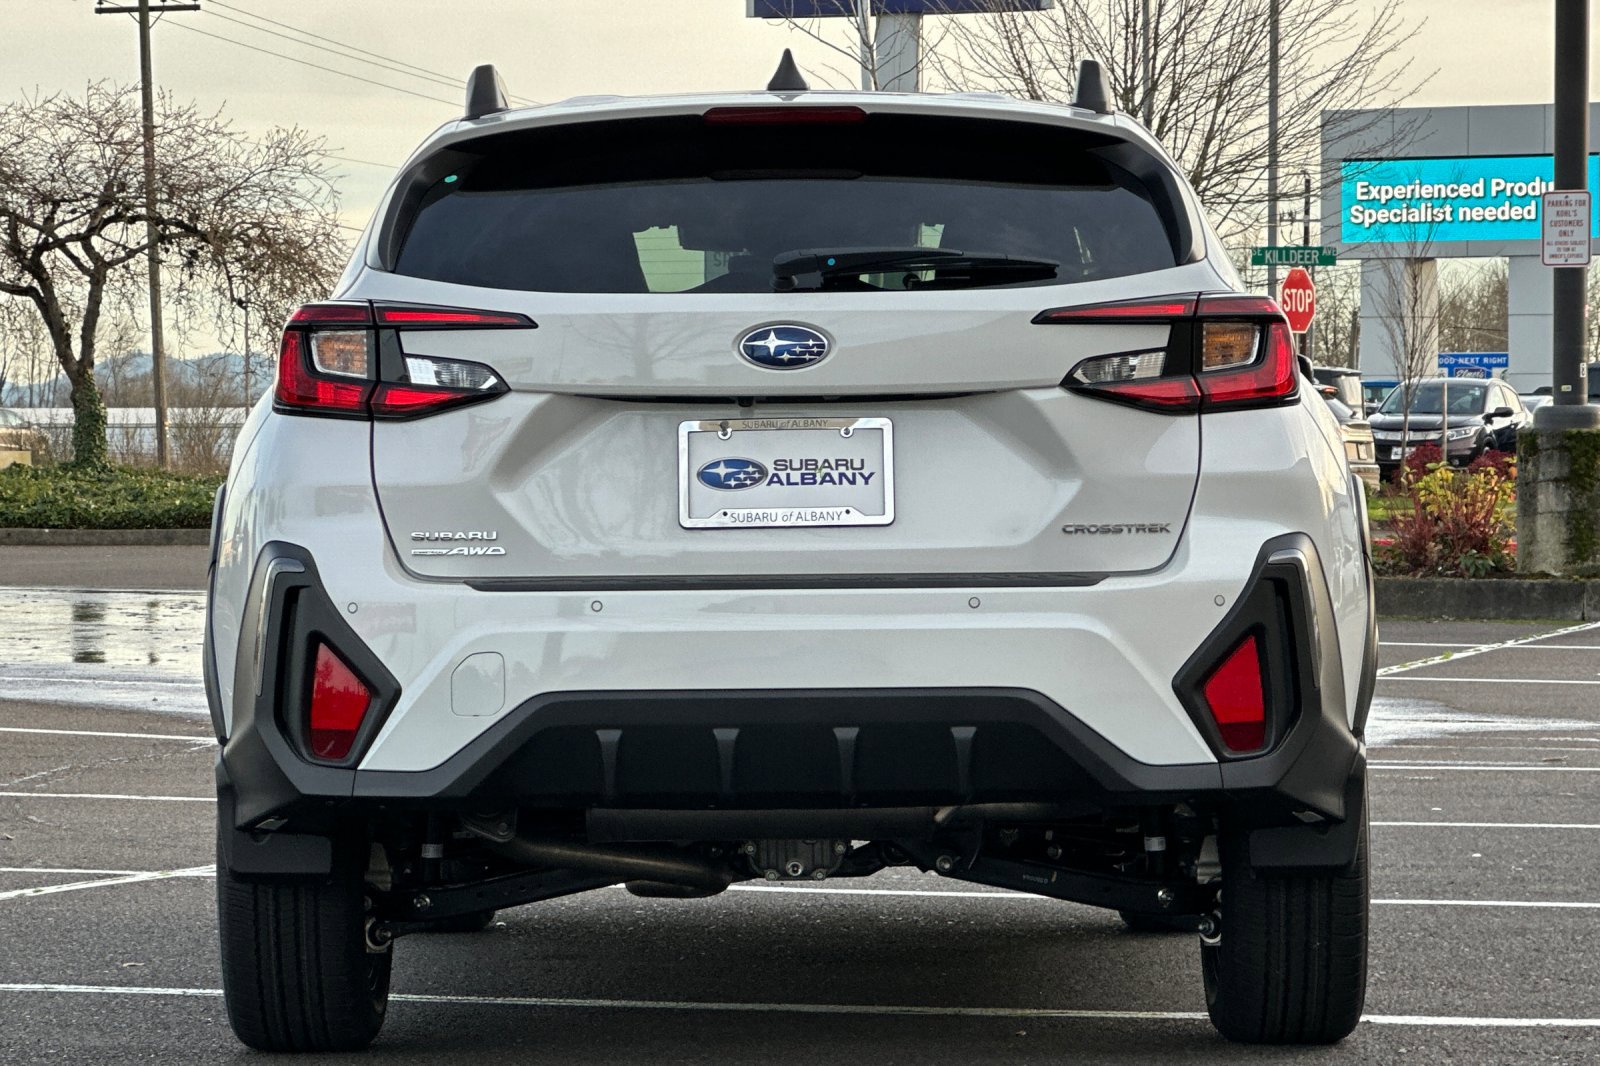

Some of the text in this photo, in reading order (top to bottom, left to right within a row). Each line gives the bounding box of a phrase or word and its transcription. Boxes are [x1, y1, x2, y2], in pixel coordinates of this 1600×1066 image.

[1356, 177, 1484, 204] Experienced
[1350, 200, 1536, 229] Specialist needed
[1252, 248, 1262, 256] SE
[1264, 249, 1319, 264] KILLDEER
[1284, 288, 1312, 312] STOP
[742, 420, 778, 428] SUBARU
[791, 420, 828, 428] ALBANY
[774, 458, 864, 471] SUBARU
[766, 472, 876, 486] ALBANY
[730, 511, 842, 522] SUBARU of ALBANY
[1062, 523, 1170, 534] CROSSTREK
[411, 531, 497, 540] SUBARU
[446, 546, 506, 555] AWD
